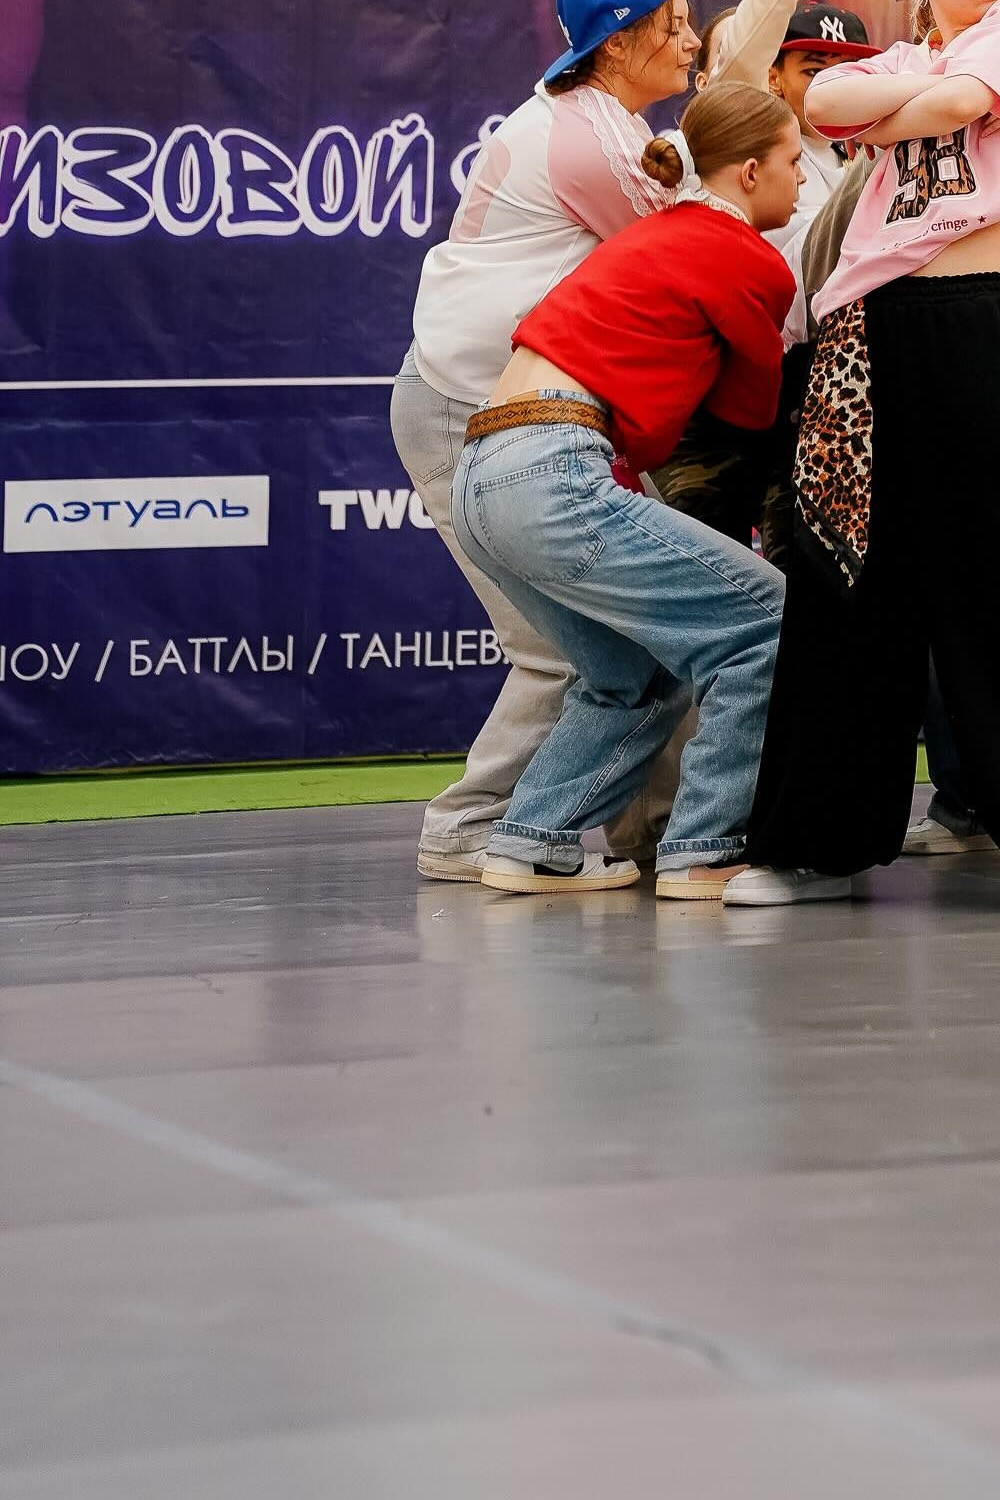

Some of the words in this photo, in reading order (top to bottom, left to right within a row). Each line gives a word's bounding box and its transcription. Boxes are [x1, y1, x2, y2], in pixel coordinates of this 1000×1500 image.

[931, 219, 969, 232] cringe
[130, 635, 293, 676] БАТТЛЫ
[341, 629, 509, 671] ТАНЦЕВ
